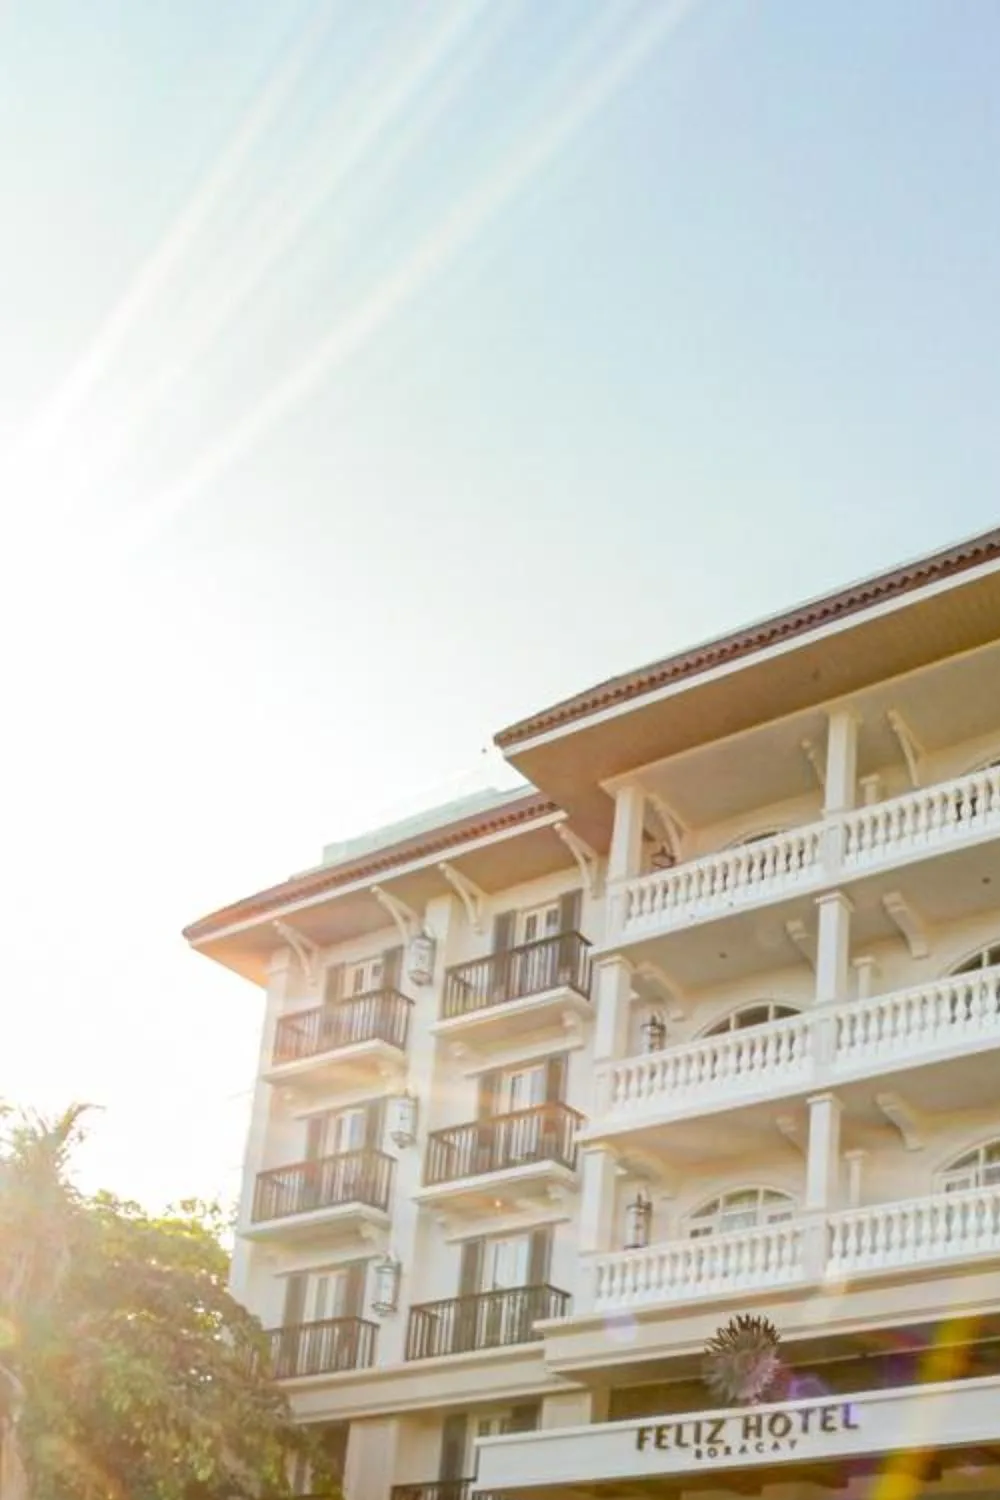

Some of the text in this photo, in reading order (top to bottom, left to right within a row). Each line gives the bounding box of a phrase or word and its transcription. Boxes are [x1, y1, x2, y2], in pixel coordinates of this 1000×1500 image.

[636, 1402, 859, 1451] FELIZ HOTEL
[693, 1439, 798, 1460] BORACAY
